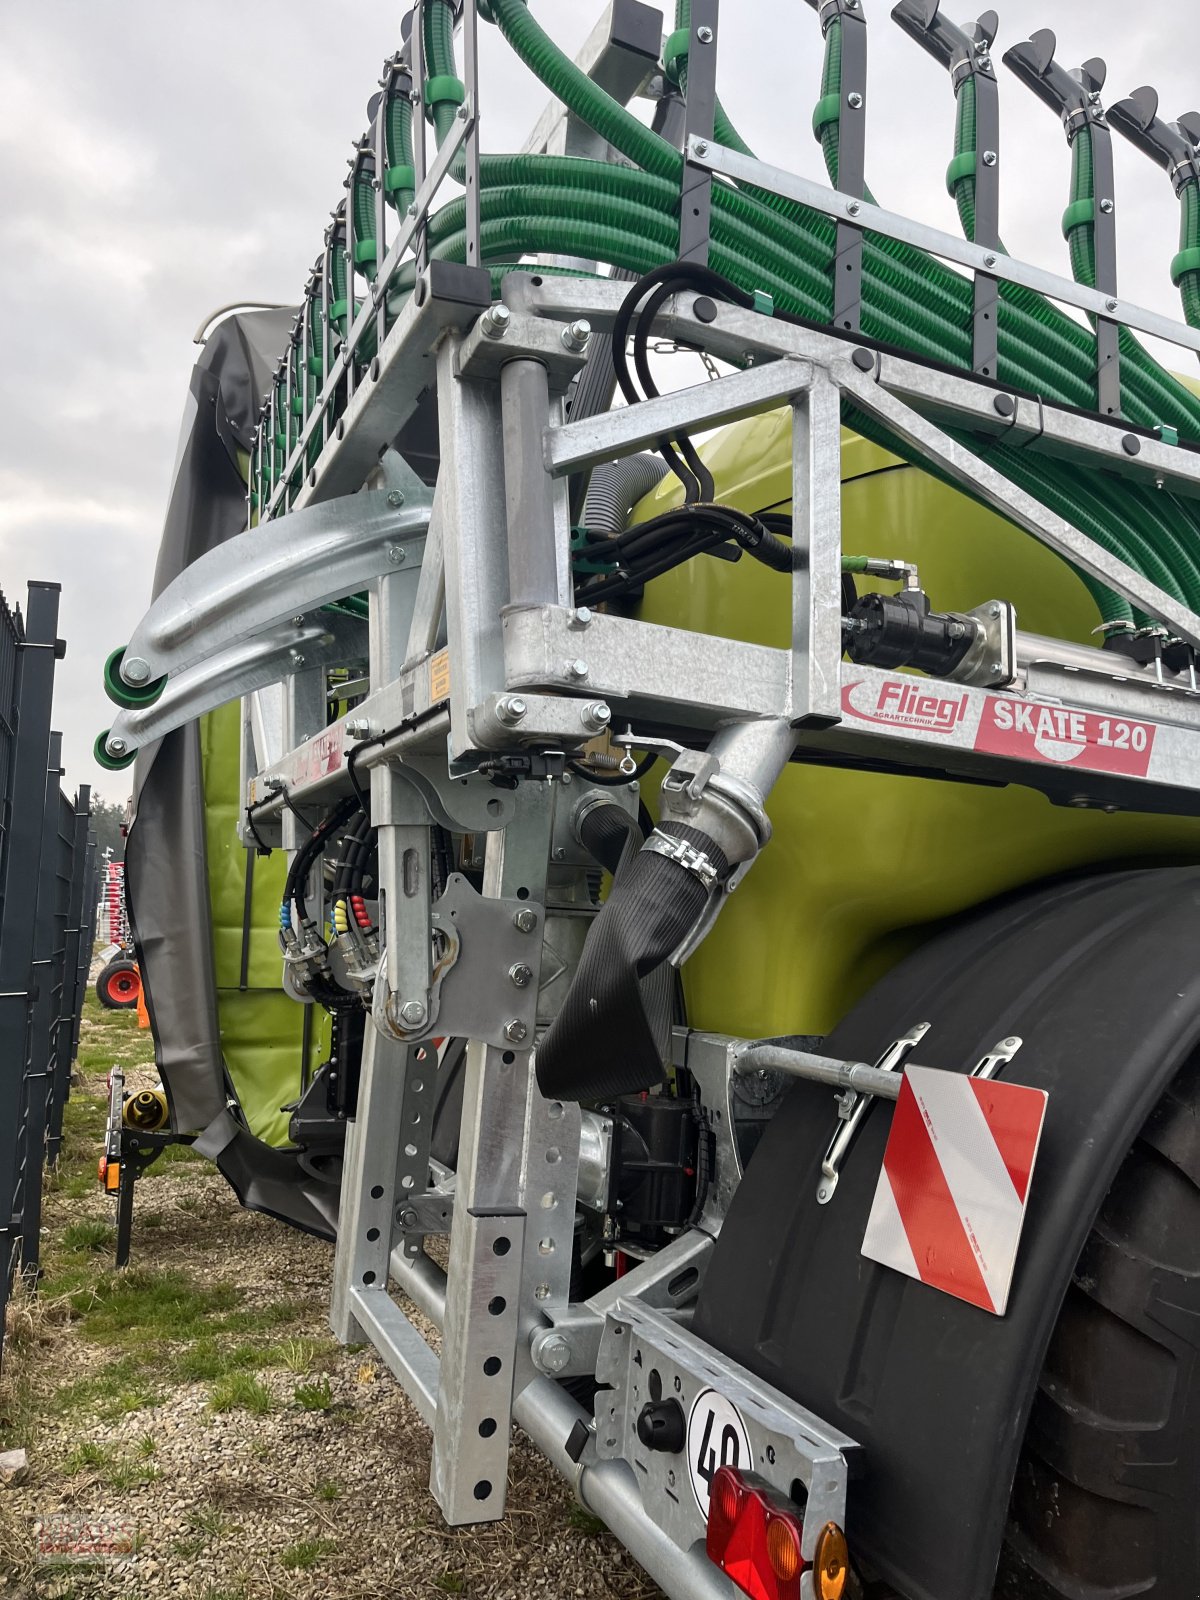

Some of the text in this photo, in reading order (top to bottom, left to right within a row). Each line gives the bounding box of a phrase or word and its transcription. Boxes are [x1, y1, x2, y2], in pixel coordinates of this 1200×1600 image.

[873, 711, 933, 726] AGRARTECHNIK
[877, 681, 969, 728] Fliegl
[993, 700, 1147, 752] SKATE 120
